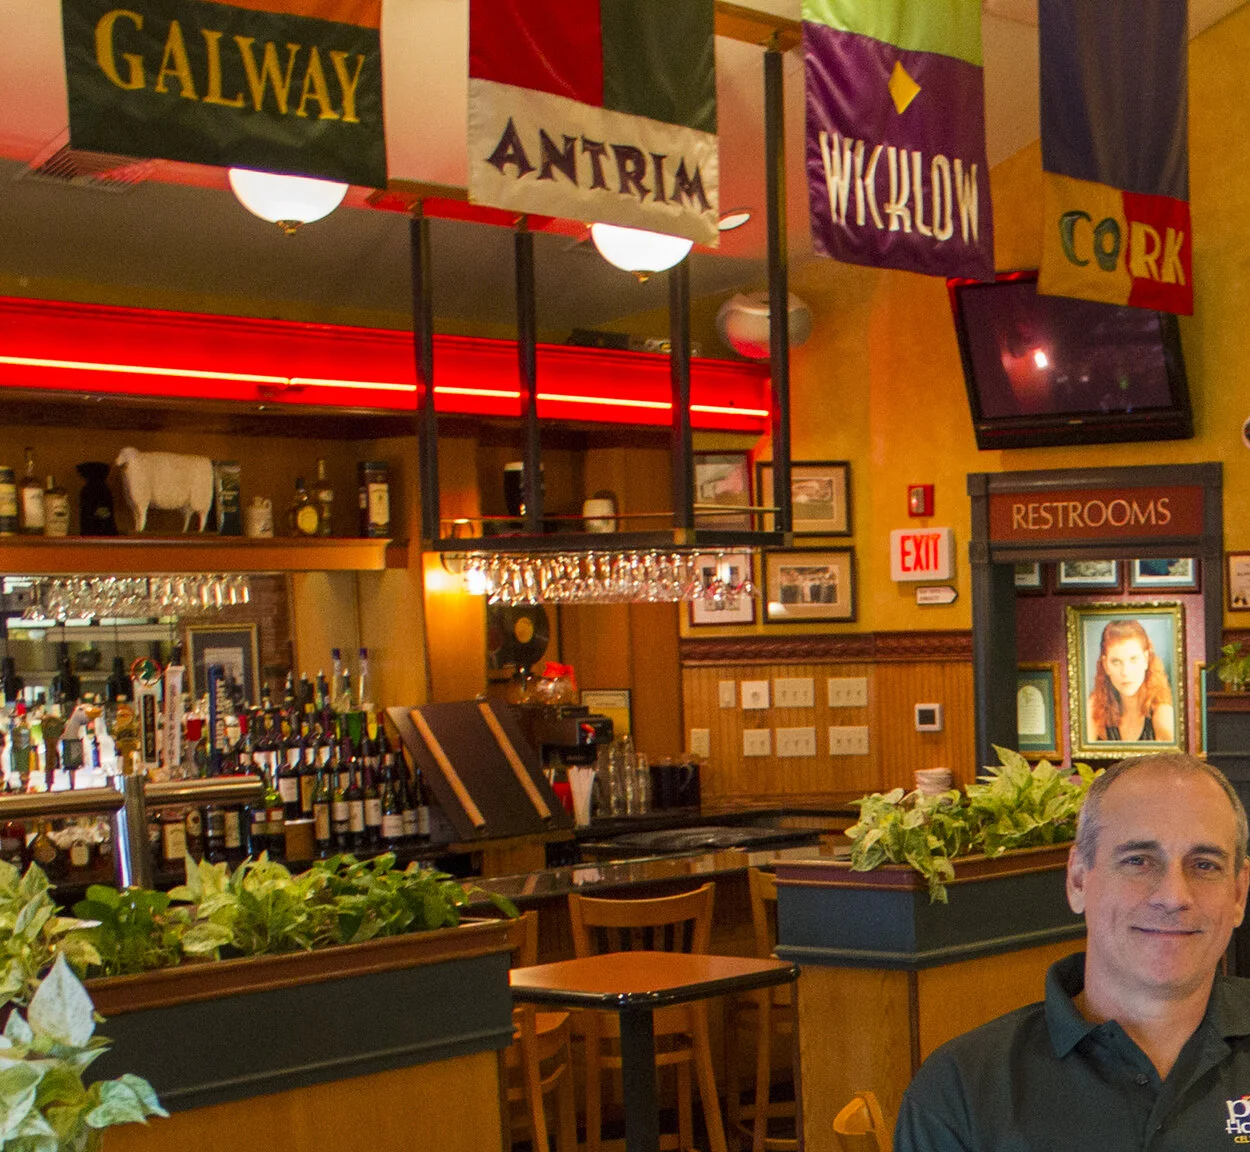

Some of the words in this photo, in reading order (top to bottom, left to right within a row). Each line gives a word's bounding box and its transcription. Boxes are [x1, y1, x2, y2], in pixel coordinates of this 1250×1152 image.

[95, 8, 366, 124] GALWAY
[486, 116, 714, 210] ANTRIM
[819, 131, 979, 246] WICKLOW
[1058, 210, 1186, 286] CORK
[900, 532, 942, 573] EXIT
[1012, 498, 1172, 530] RESTROOMS
